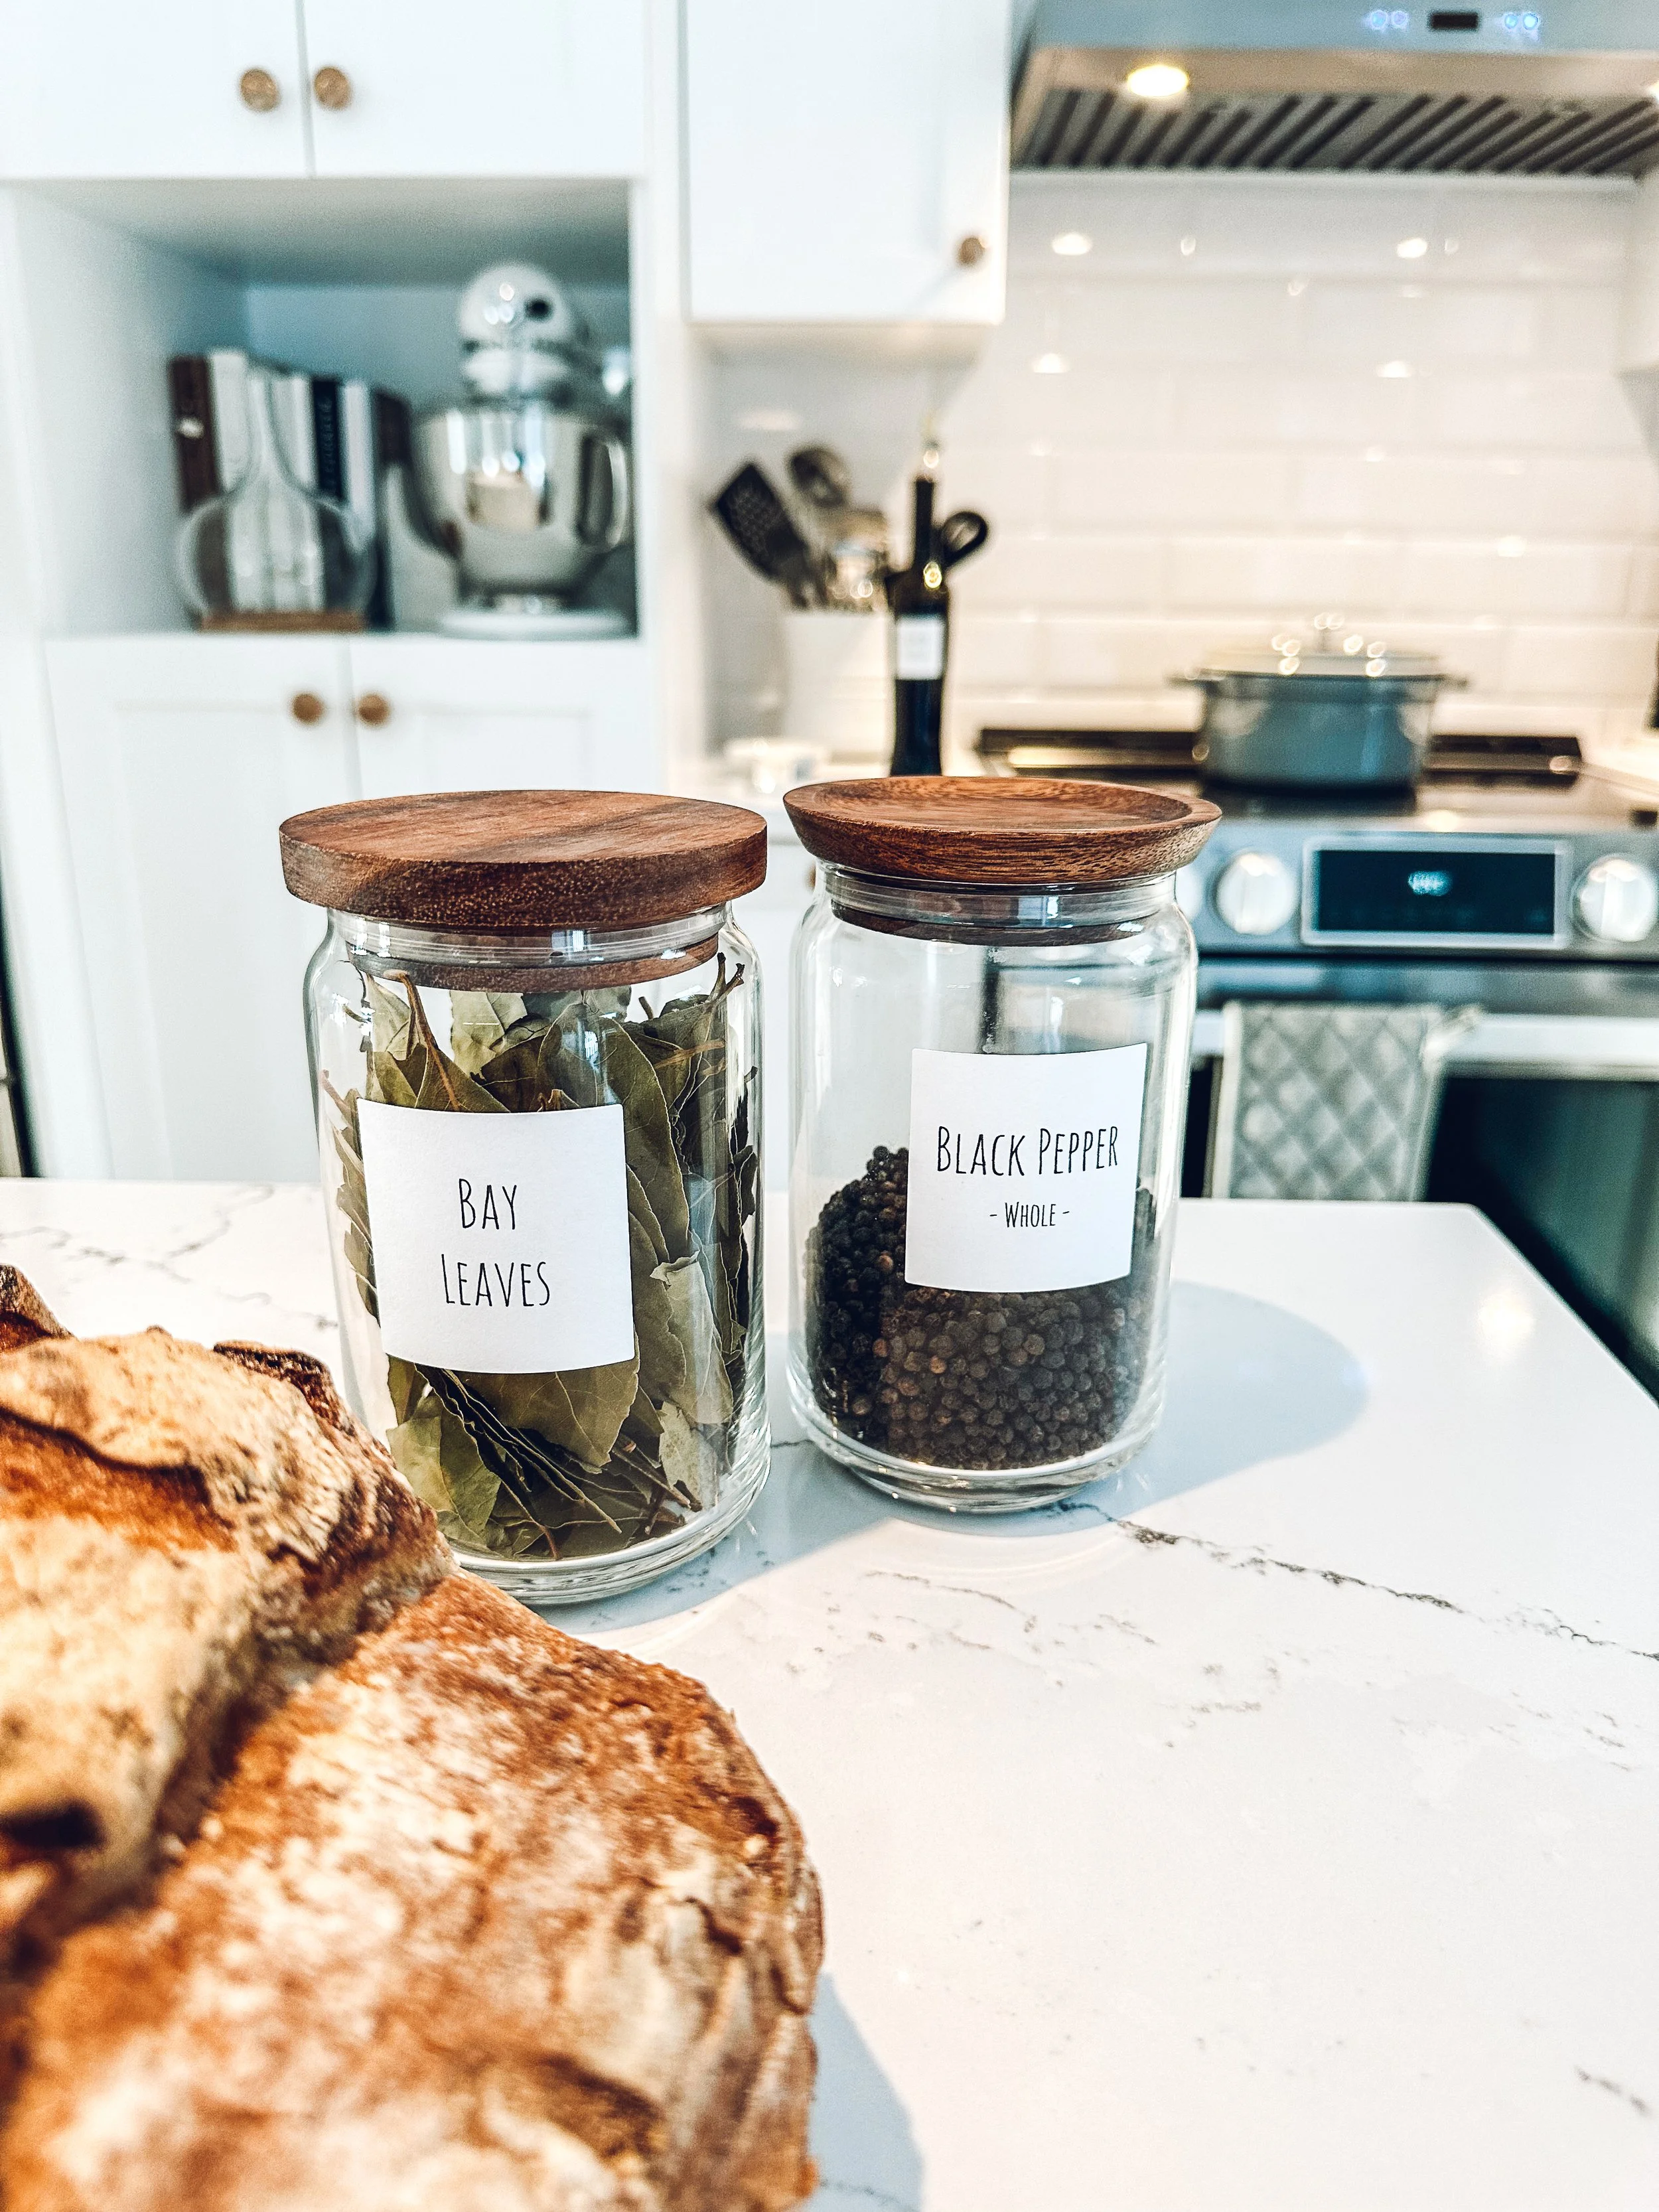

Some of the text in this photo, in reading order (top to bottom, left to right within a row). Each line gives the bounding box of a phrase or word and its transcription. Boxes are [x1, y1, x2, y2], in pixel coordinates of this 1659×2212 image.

[937, 1126, 1118, 1177] BLACK PEPPER
[459, 1178, 518, 1230] BAY
[441, 1254, 551, 1307] LEAVES
